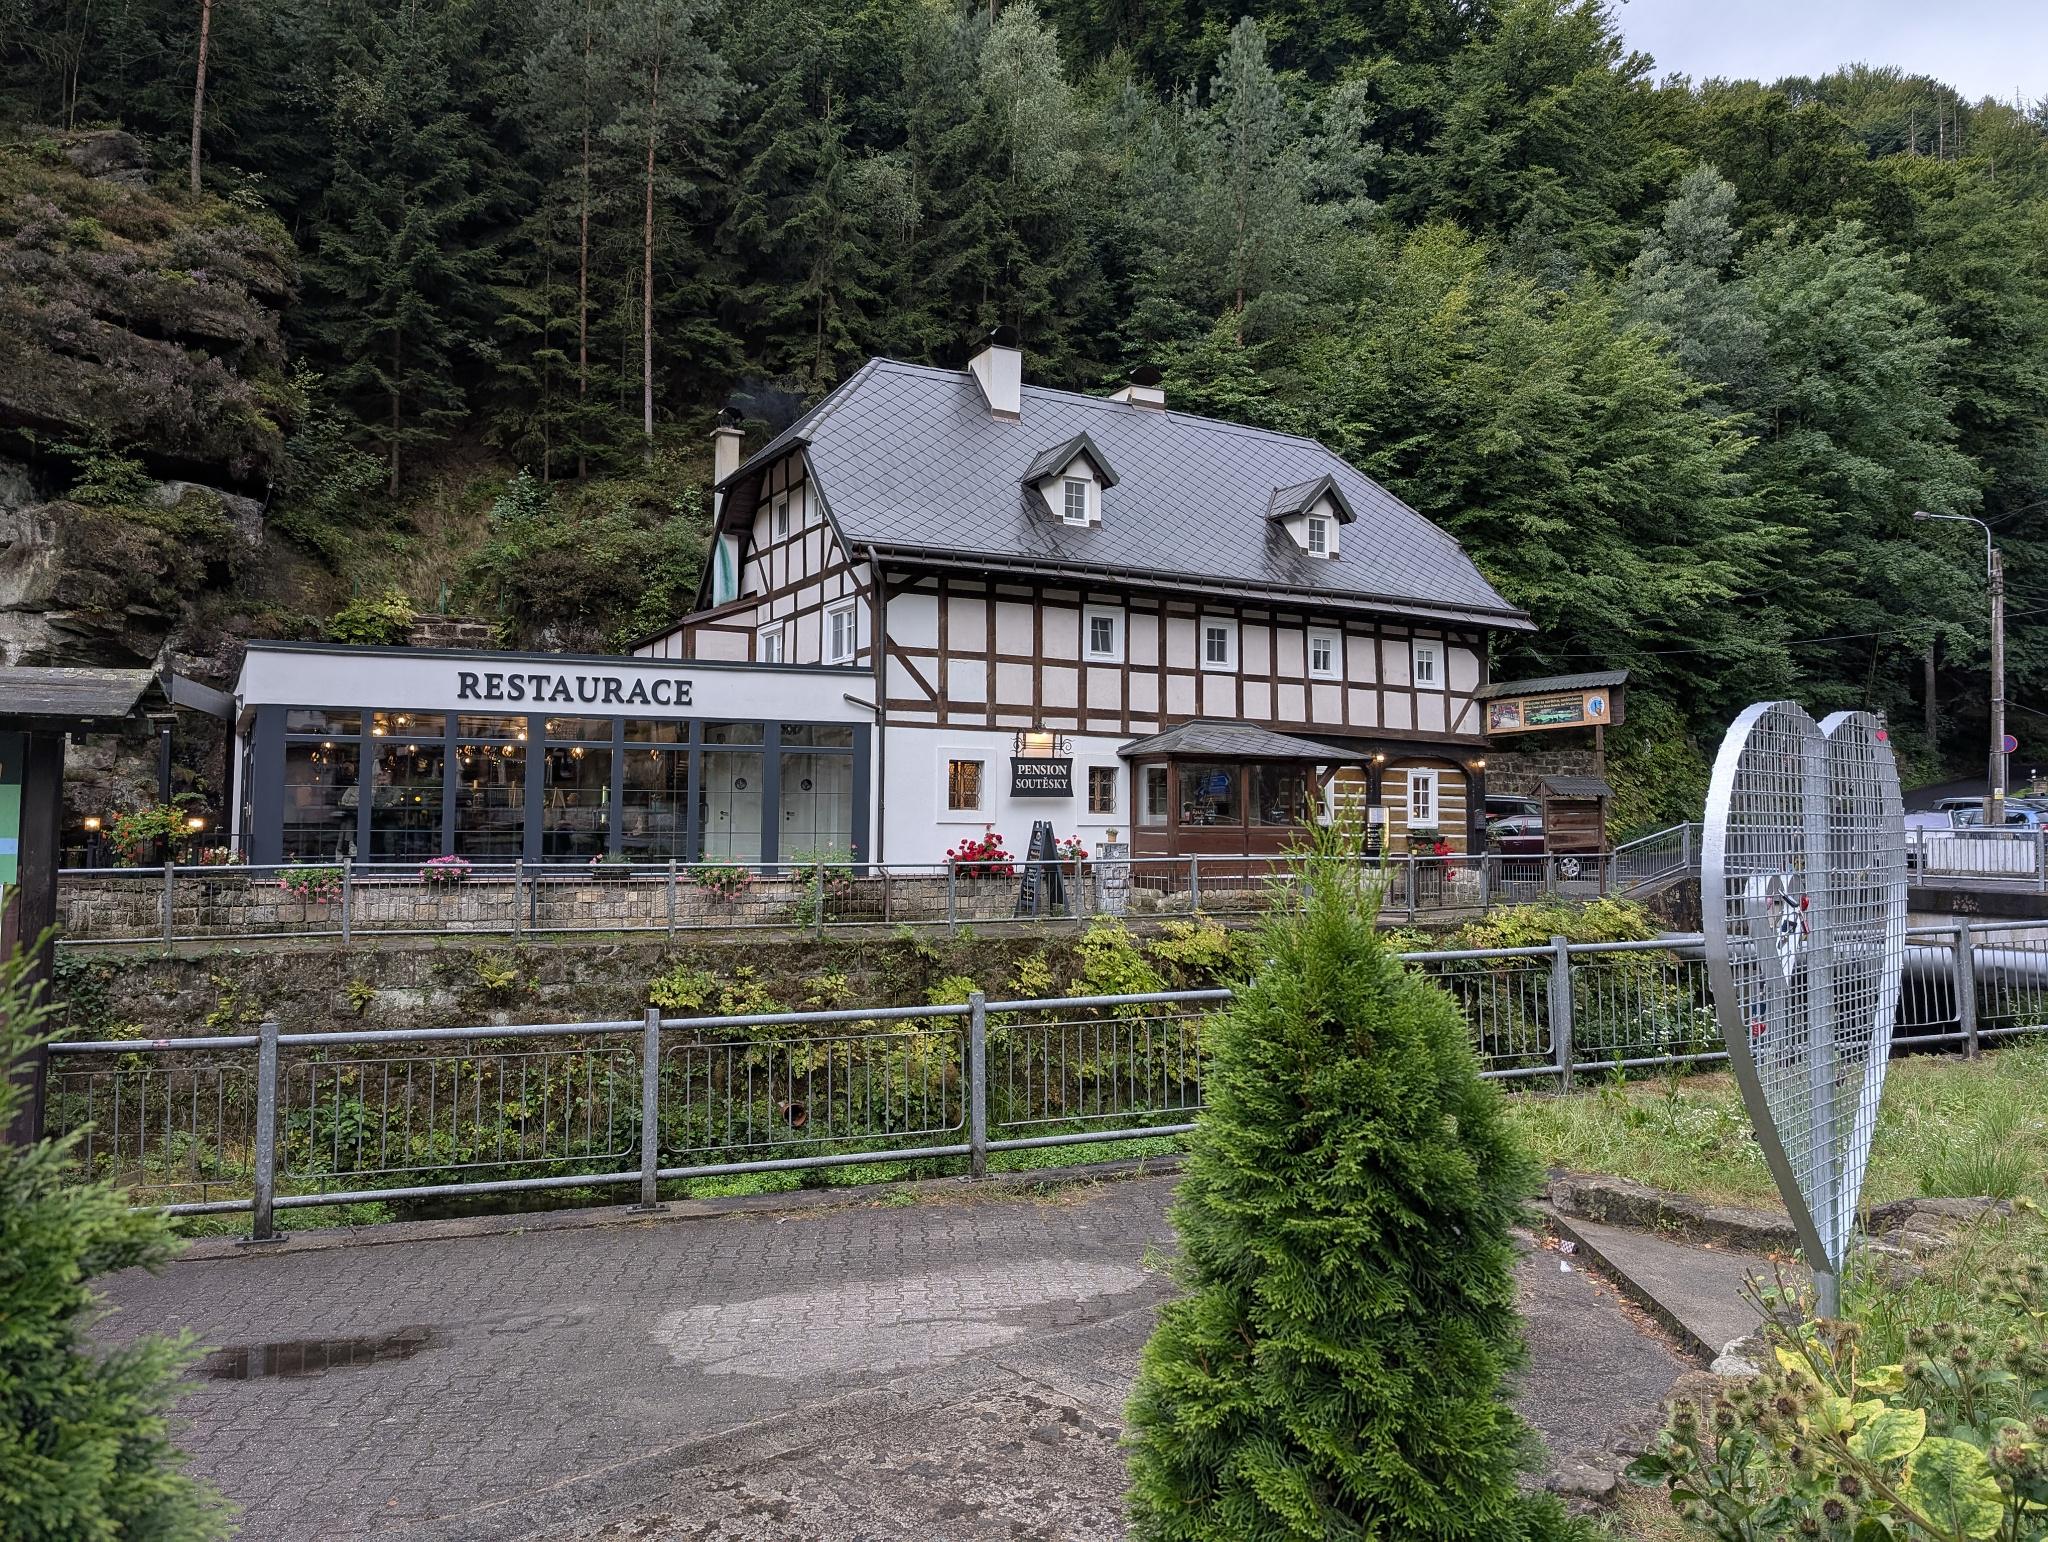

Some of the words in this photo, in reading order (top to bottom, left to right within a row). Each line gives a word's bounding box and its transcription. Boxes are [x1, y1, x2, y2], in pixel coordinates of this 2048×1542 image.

[457, 671, 693, 706] RESTAURACE
[1017, 764, 1067, 775] PENSION
[1015, 777, 1068, 789] SOUTĚSKY
